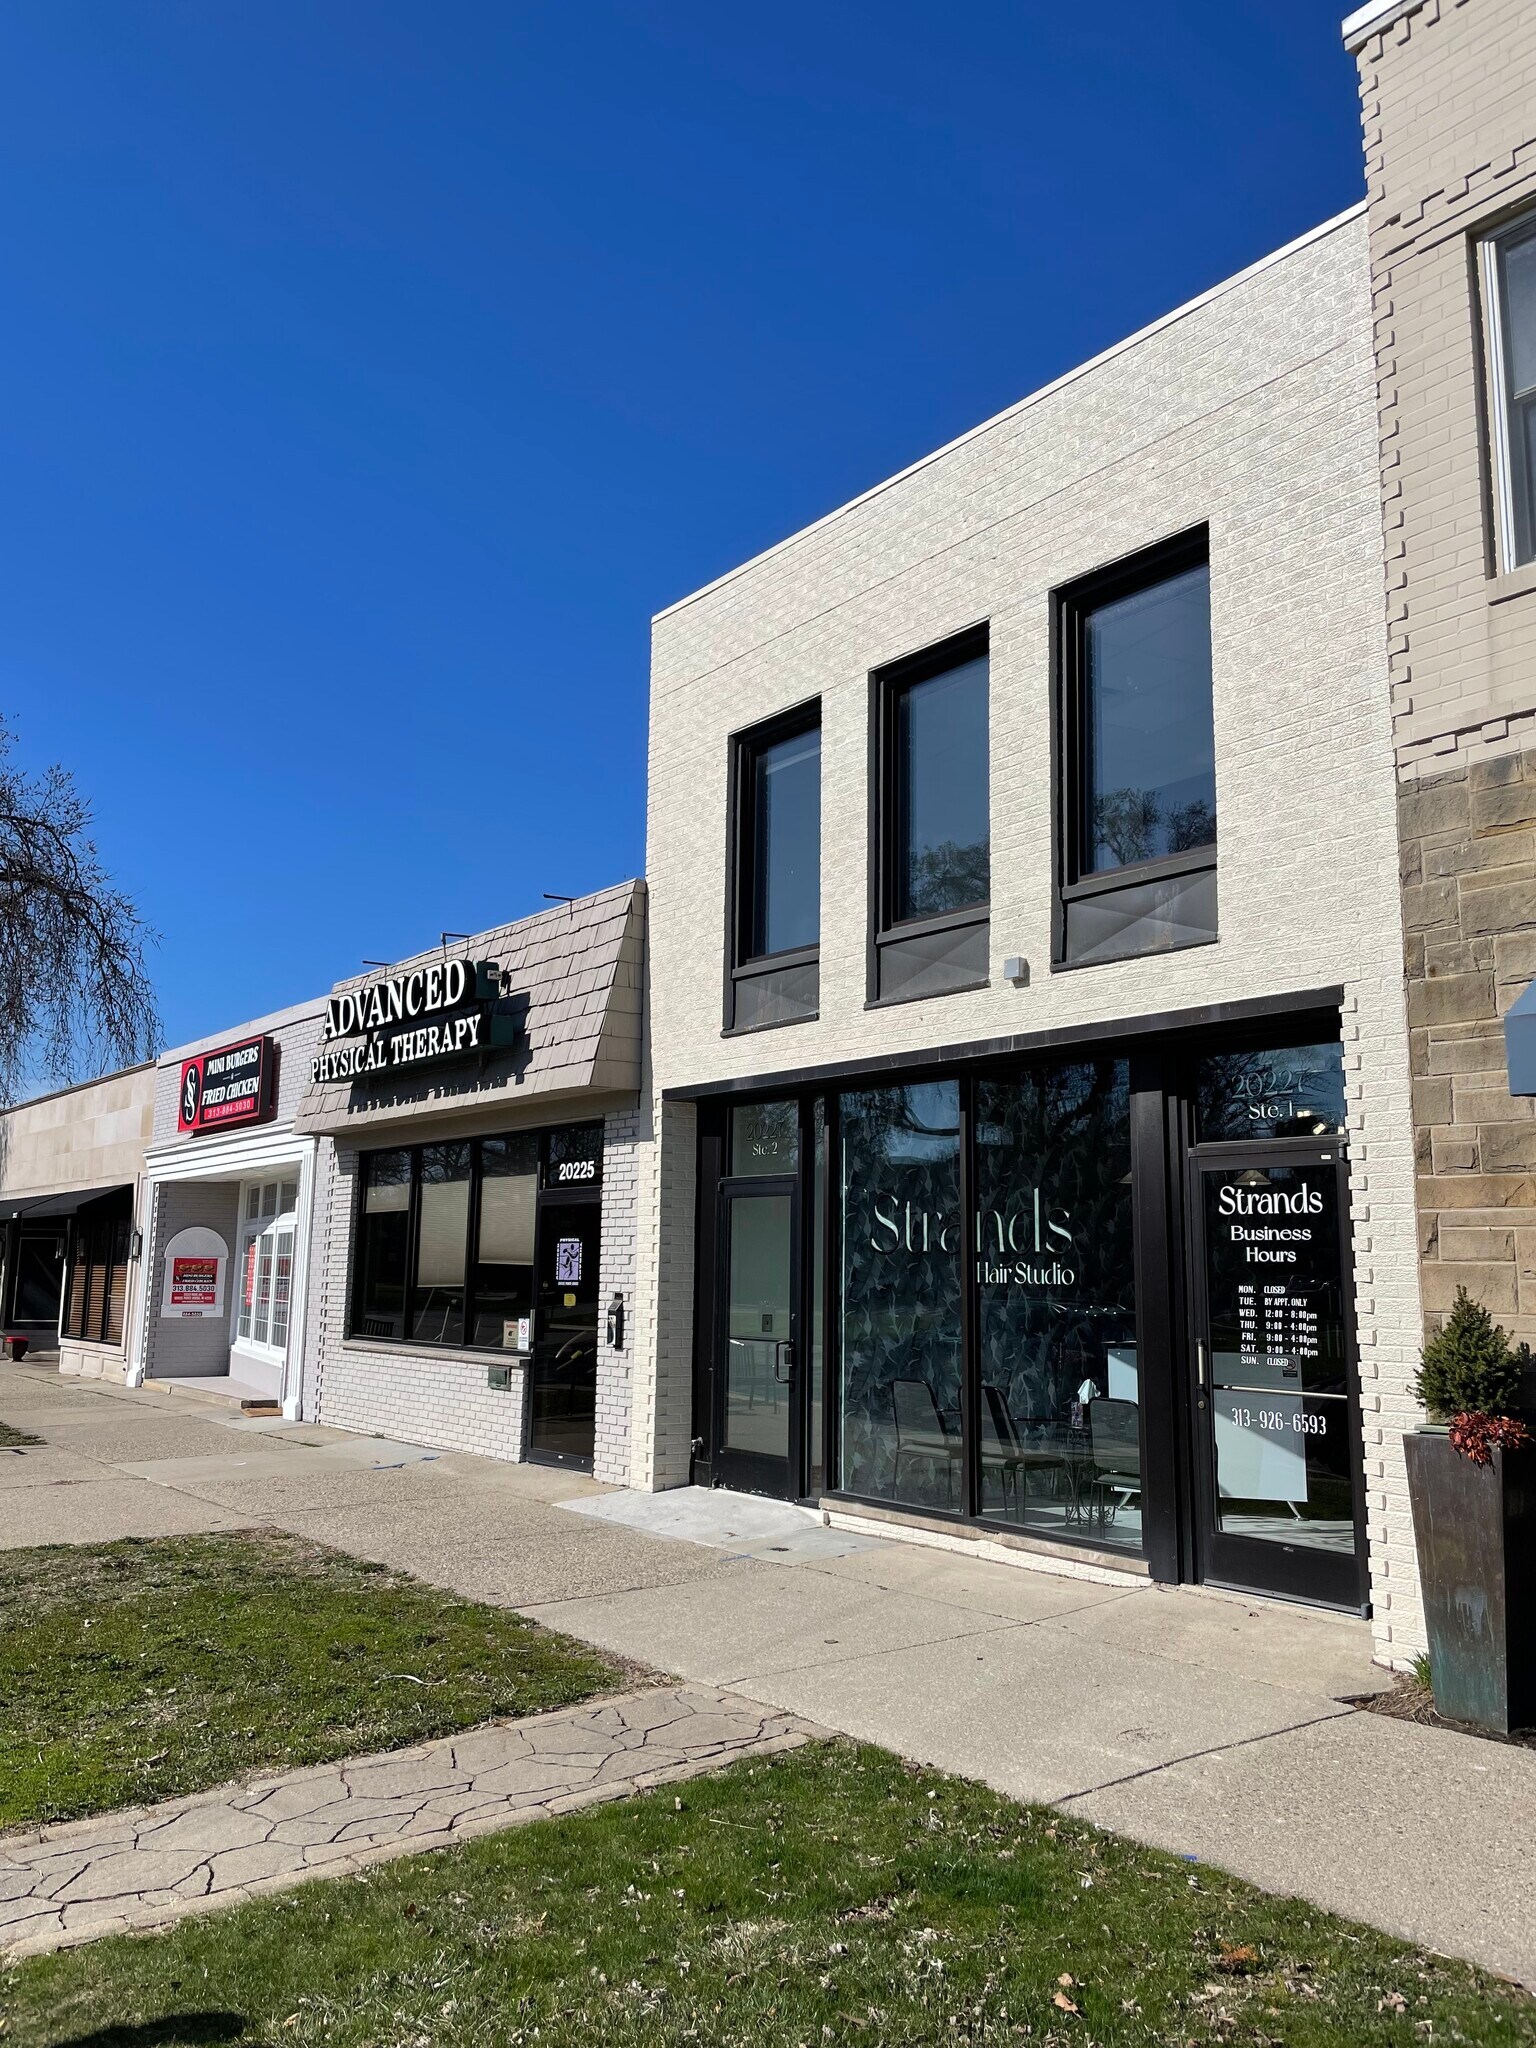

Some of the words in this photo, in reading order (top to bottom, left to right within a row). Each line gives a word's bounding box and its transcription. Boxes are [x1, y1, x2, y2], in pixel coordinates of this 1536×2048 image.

[321, 959, 465, 1040] ADVANCED
[310, 1040, 387, 1083] PHYSICAL
[391, 1014, 482, 1065] THERAPY
[206, 1057, 225, 1076] MINI
[225, 1046, 260, 1071] BURGERS
[201, 1086, 226, 1106] FRIED
[226, 1076, 260, 1101] CHICKEN
[1231, 1069, 1308, 1099] 20227
[207, 1100, 251, 1118] 313-884-5030
[1248, 1102, 1283, 1119] Ste.
[1288, 1100, 1293, 1117] 1
[752, 1143, 770, 1156] Ste.
[771, 1142, 778, 1154] 2
[558, 1160, 595, 1181] 20225
[1218, 1182, 1324, 1215] Strands
[1230, 1225, 1312, 1241] Business
[1246, 1246, 1297, 1262] Hours
[976, 1261, 1013, 1284] Hair
[1014, 1260, 1075, 1285] Studio
[1238, 1285, 1256, 1294] MON.
[1263, 1285, 1286, 1294] CLOSED
[1239, 1297, 1257, 1306] TUE.
[1264, 1297, 1273, 1306] BY
[1273, 1297, 1290, 1306] APPT.
[1290, 1298, 1308, 1307] ONLY
[1239, 1308, 1258, 1317] WED.
[1265, 1309, 1283, 1318] 12:00
[1290, 1310, 1317, 1321] 8:00pm
[1240, 1320, 1258, 1329] THU.
[1265, 1321, 1282, 1330] 9:00
[1290, 1322, 1317, 1333] 4:00pm
[1241, 1332, 1257, 1341] FRI.
[1266, 1333, 1283, 1342] 9:00
[1290, 1334, 1318, 1345] 4:00pm
[1240, 1344, 1259, 1353] SAT.
[1266, 1345, 1283, 1354] 9:00
[1291, 1346, 1319, 1358] 4:00pm
[1240, 1356, 1259, 1365] SUN.
[1266, 1357, 1289, 1367] CLOSED
[1231, 1407, 1327, 1435] 313-926-6593
